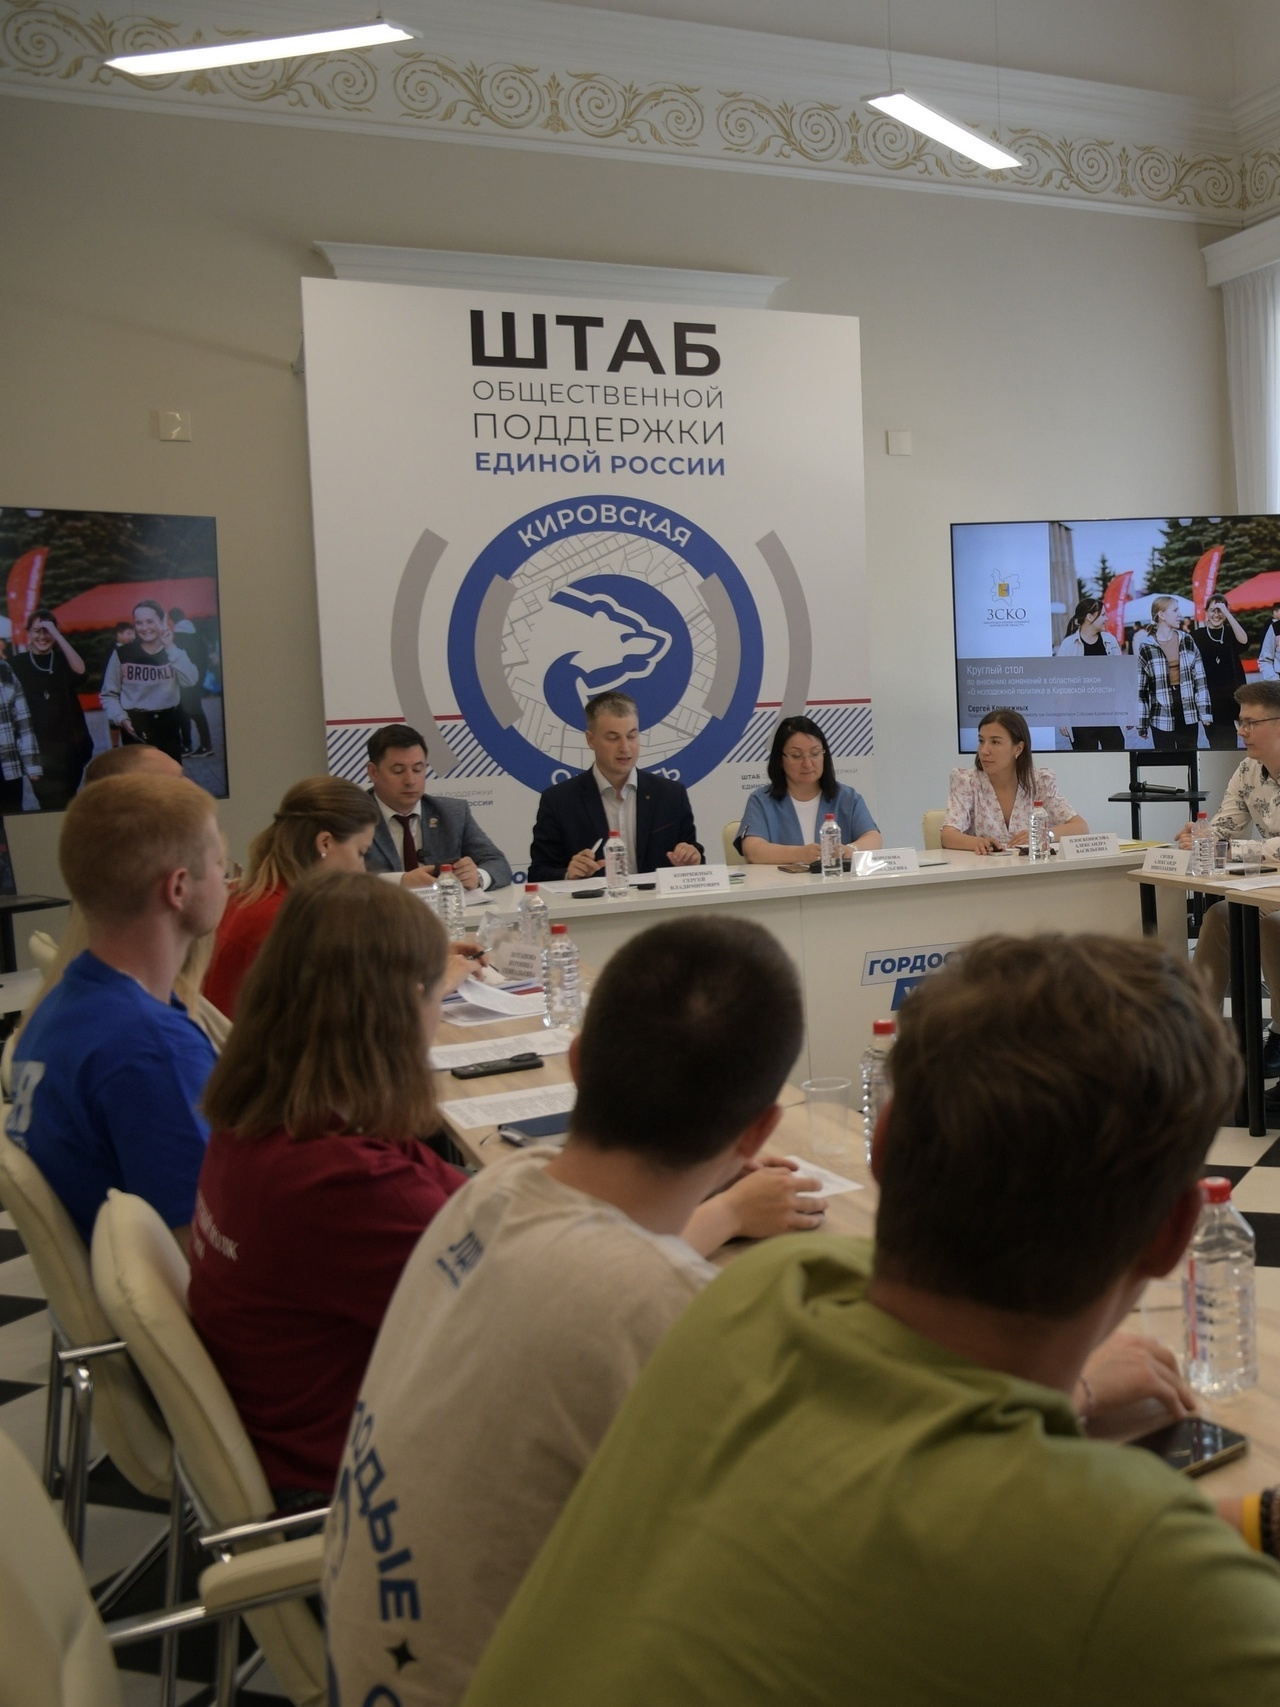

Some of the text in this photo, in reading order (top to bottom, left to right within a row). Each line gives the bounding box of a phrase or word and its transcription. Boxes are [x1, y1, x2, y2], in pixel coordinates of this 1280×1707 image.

[470, 309, 721, 377] ШТАБ
[473, 380, 723, 409] ОБЩЕСТВЕННОЙ
[474, 412, 724, 446] ПОДДЕРЖКИ
[475, 450, 725, 476] ЕДИНОЙ РОССИИ
[517, 503, 692, 548] КИРОВСКАЯ
[966, 665, 1024, 676] Круглый стол
[1049, 676, 1082, 684] областной
[1052, 686, 1086, 695] Кировской
[968, 704, 990, 713] Сергей
